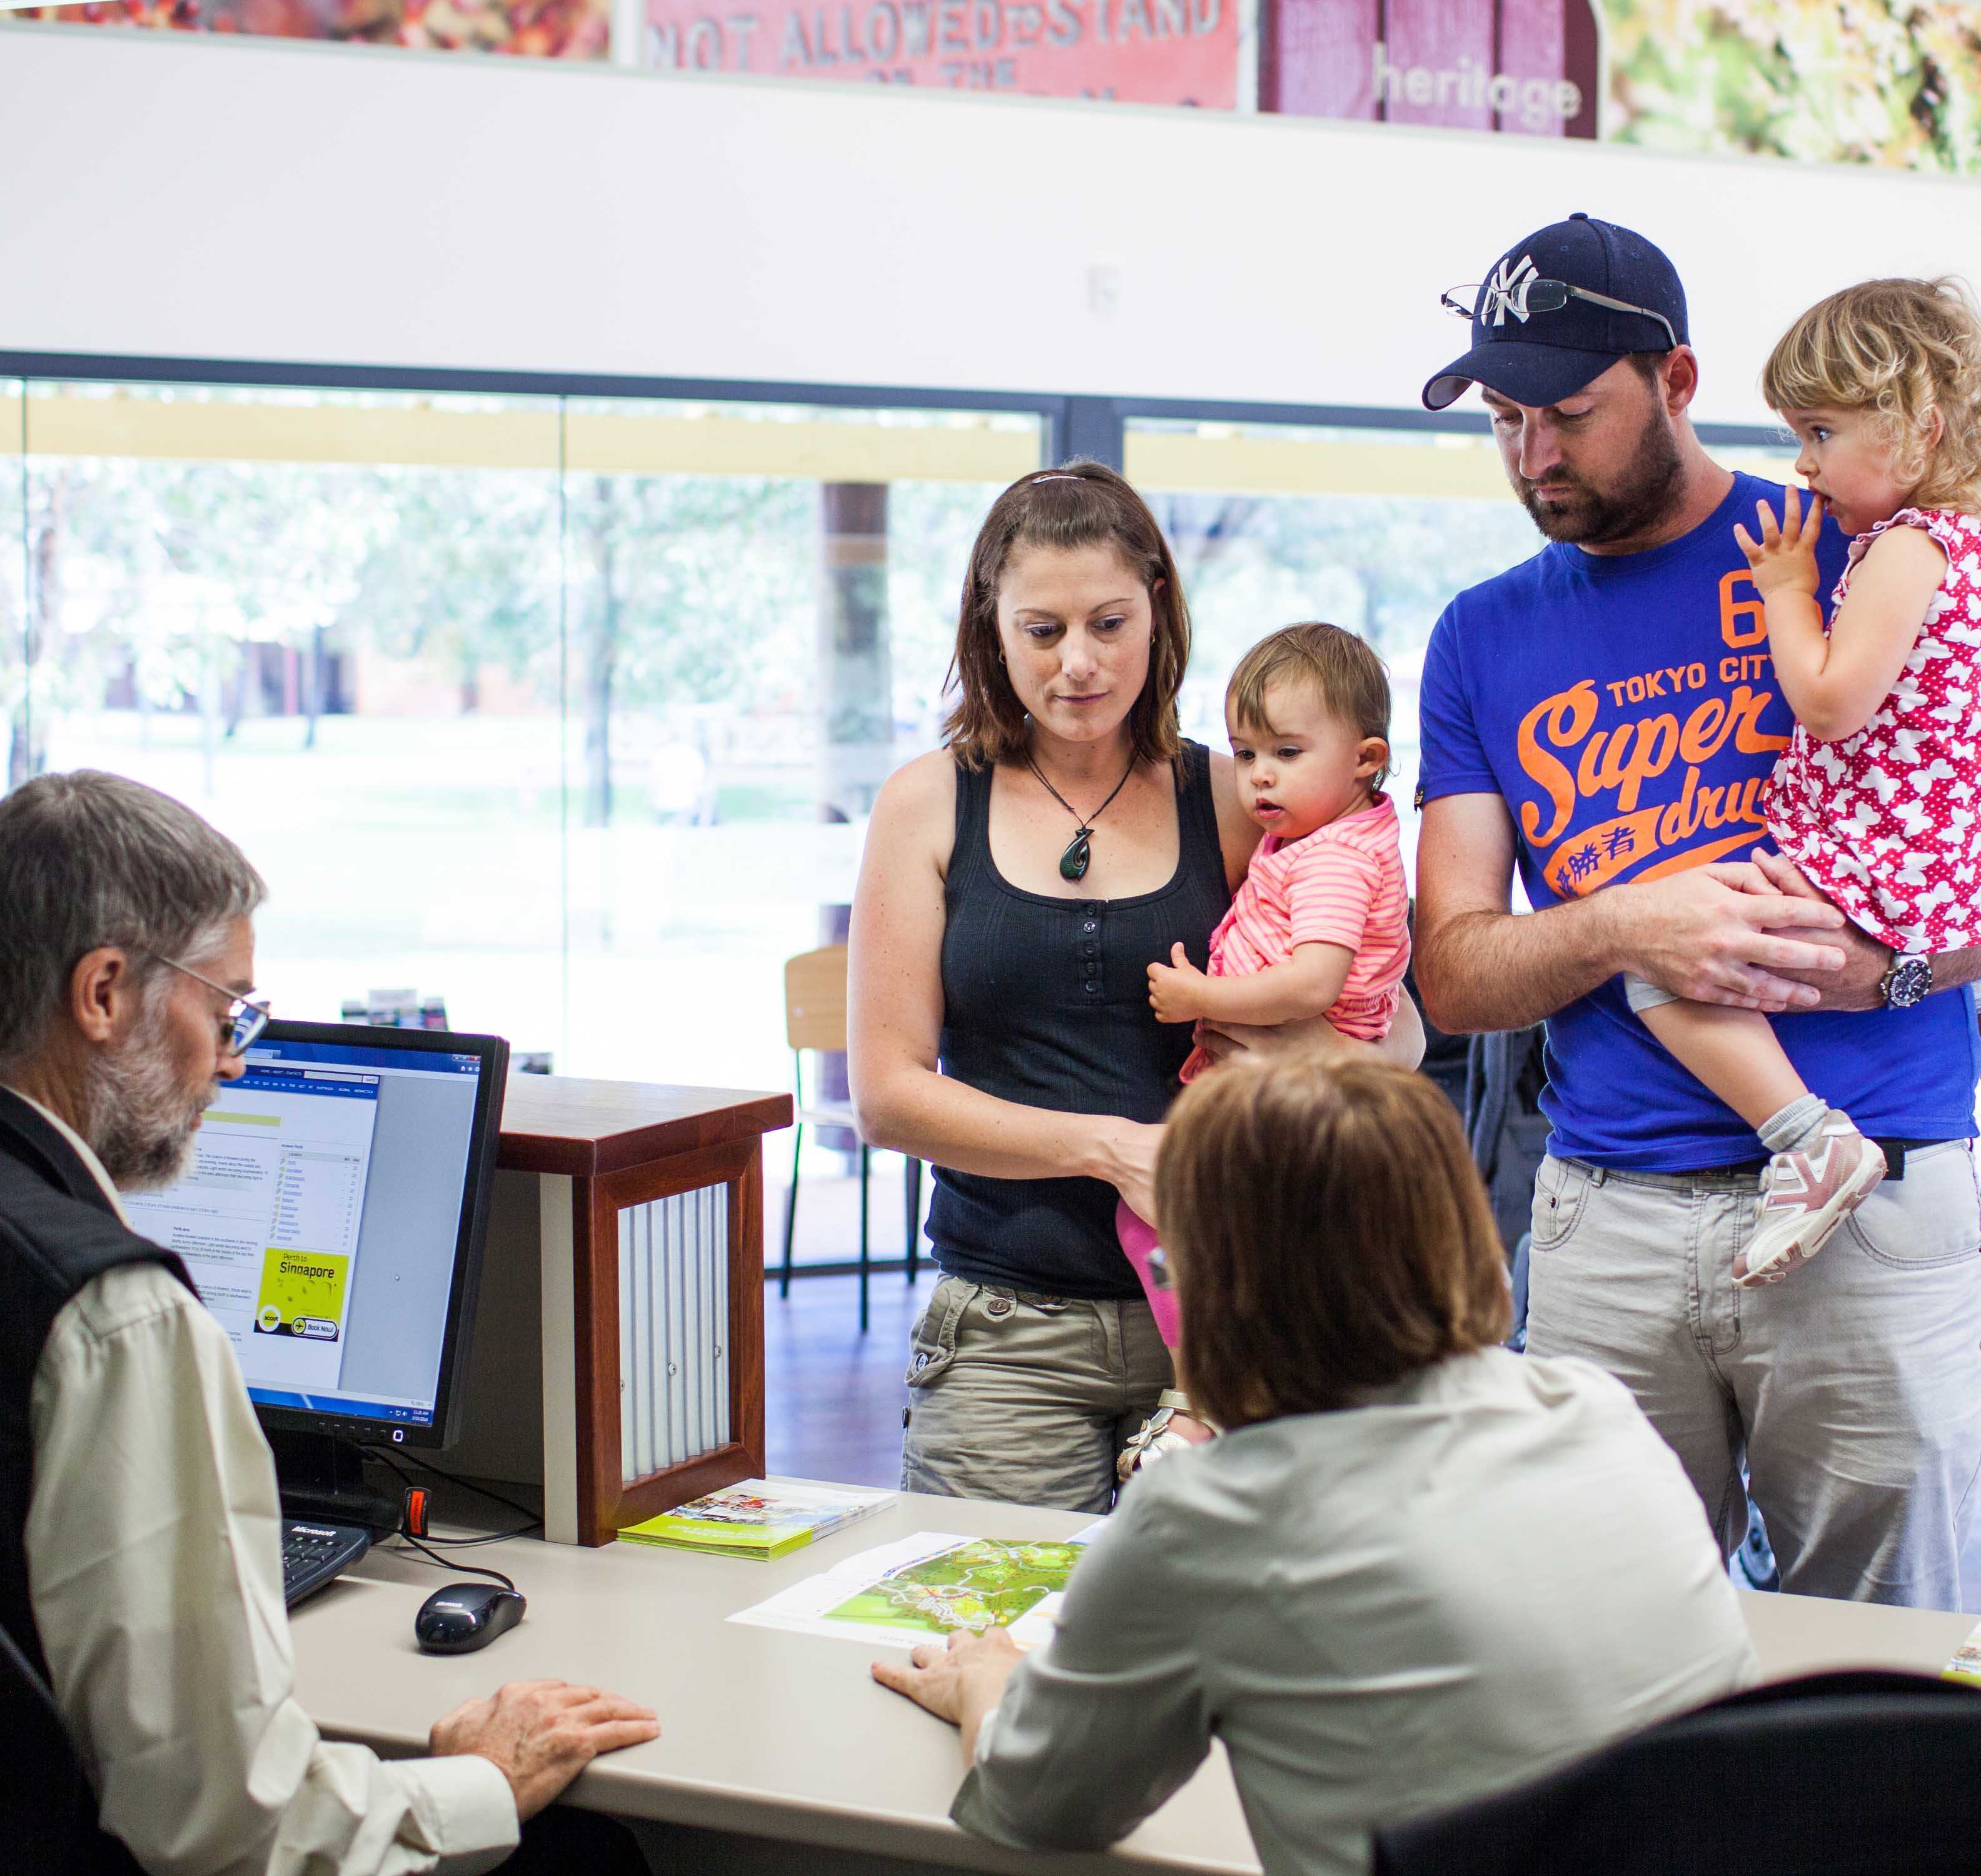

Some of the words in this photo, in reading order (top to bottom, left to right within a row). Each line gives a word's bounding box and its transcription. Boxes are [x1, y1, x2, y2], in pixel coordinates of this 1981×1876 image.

[646, 13, 758, 71] NOT
[780, 0, 1001, 69] ALLOWED
[1046, 0, 1220, 48] STAND
[1371, 41, 1583, 128] heritage
[1606, 663, 1706, 707] TOKYO
[1518, 680, 1792, 848] Super
[1660, 766, 1769, 845] dru
[280, 1261, 335, 1279] Singapore
[283, 1253, 300, 1261] Perth
[291, 1526, 337, 1536] Microsoft
